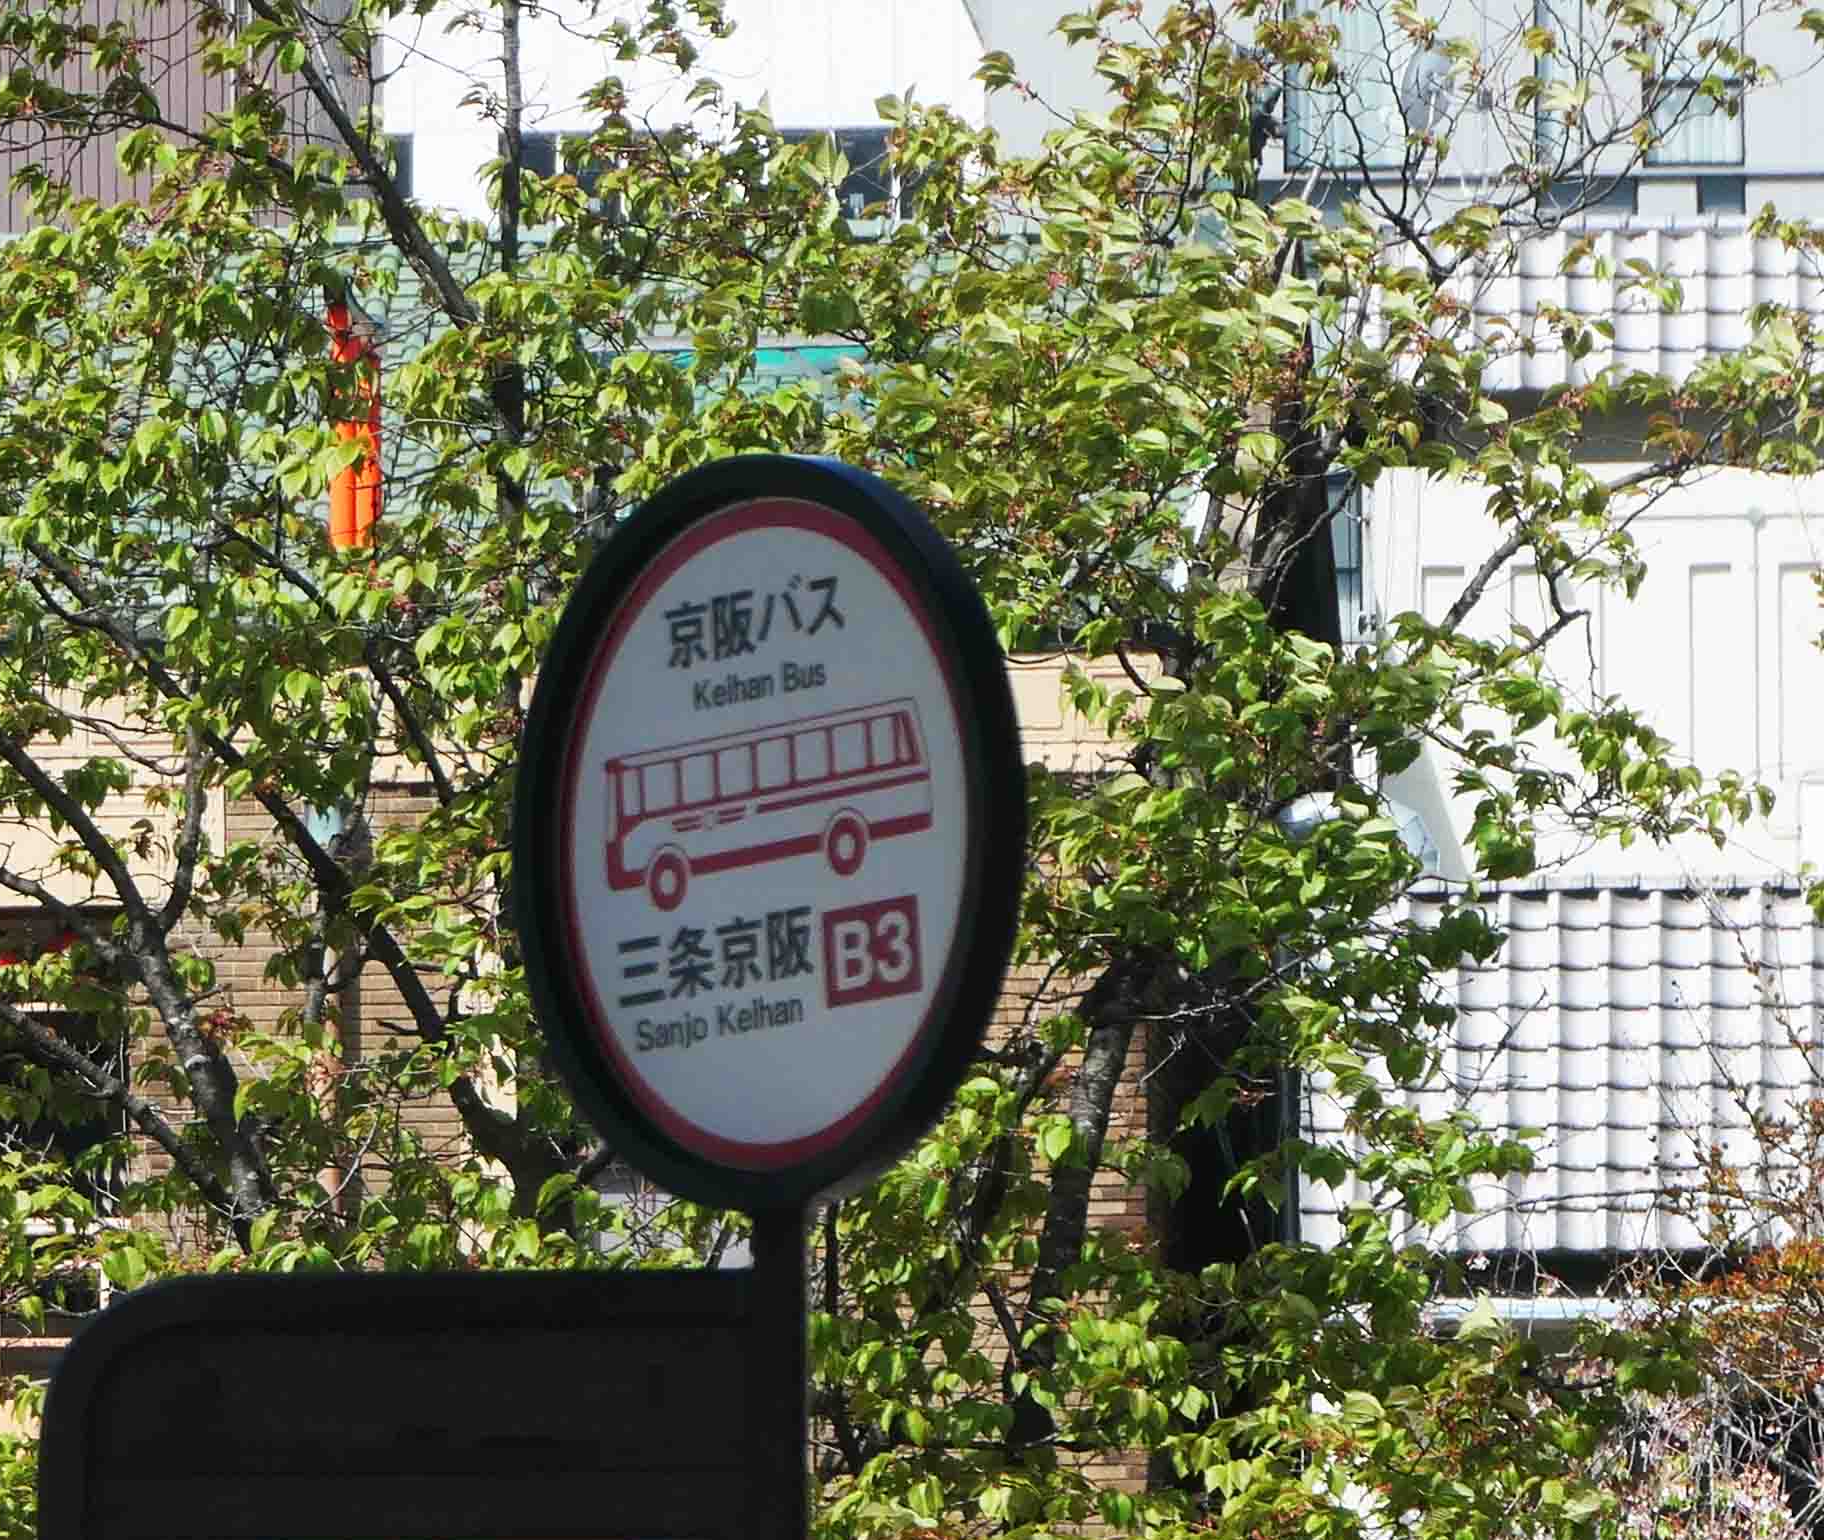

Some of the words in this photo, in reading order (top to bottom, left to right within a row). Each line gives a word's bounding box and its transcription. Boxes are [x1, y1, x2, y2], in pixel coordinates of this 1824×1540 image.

[664, 575, 846, 669] 京阪バス
[692, 672, 774, 710] Keihan
[781, 661, 827, 692] Bus
[617, 906, 814, 1008] 三条京阪
[832, 910, 912, 991] B3
[636, 1011, 709, 1051] Sanjo
[716, 995, 805, 1037] Keihan
